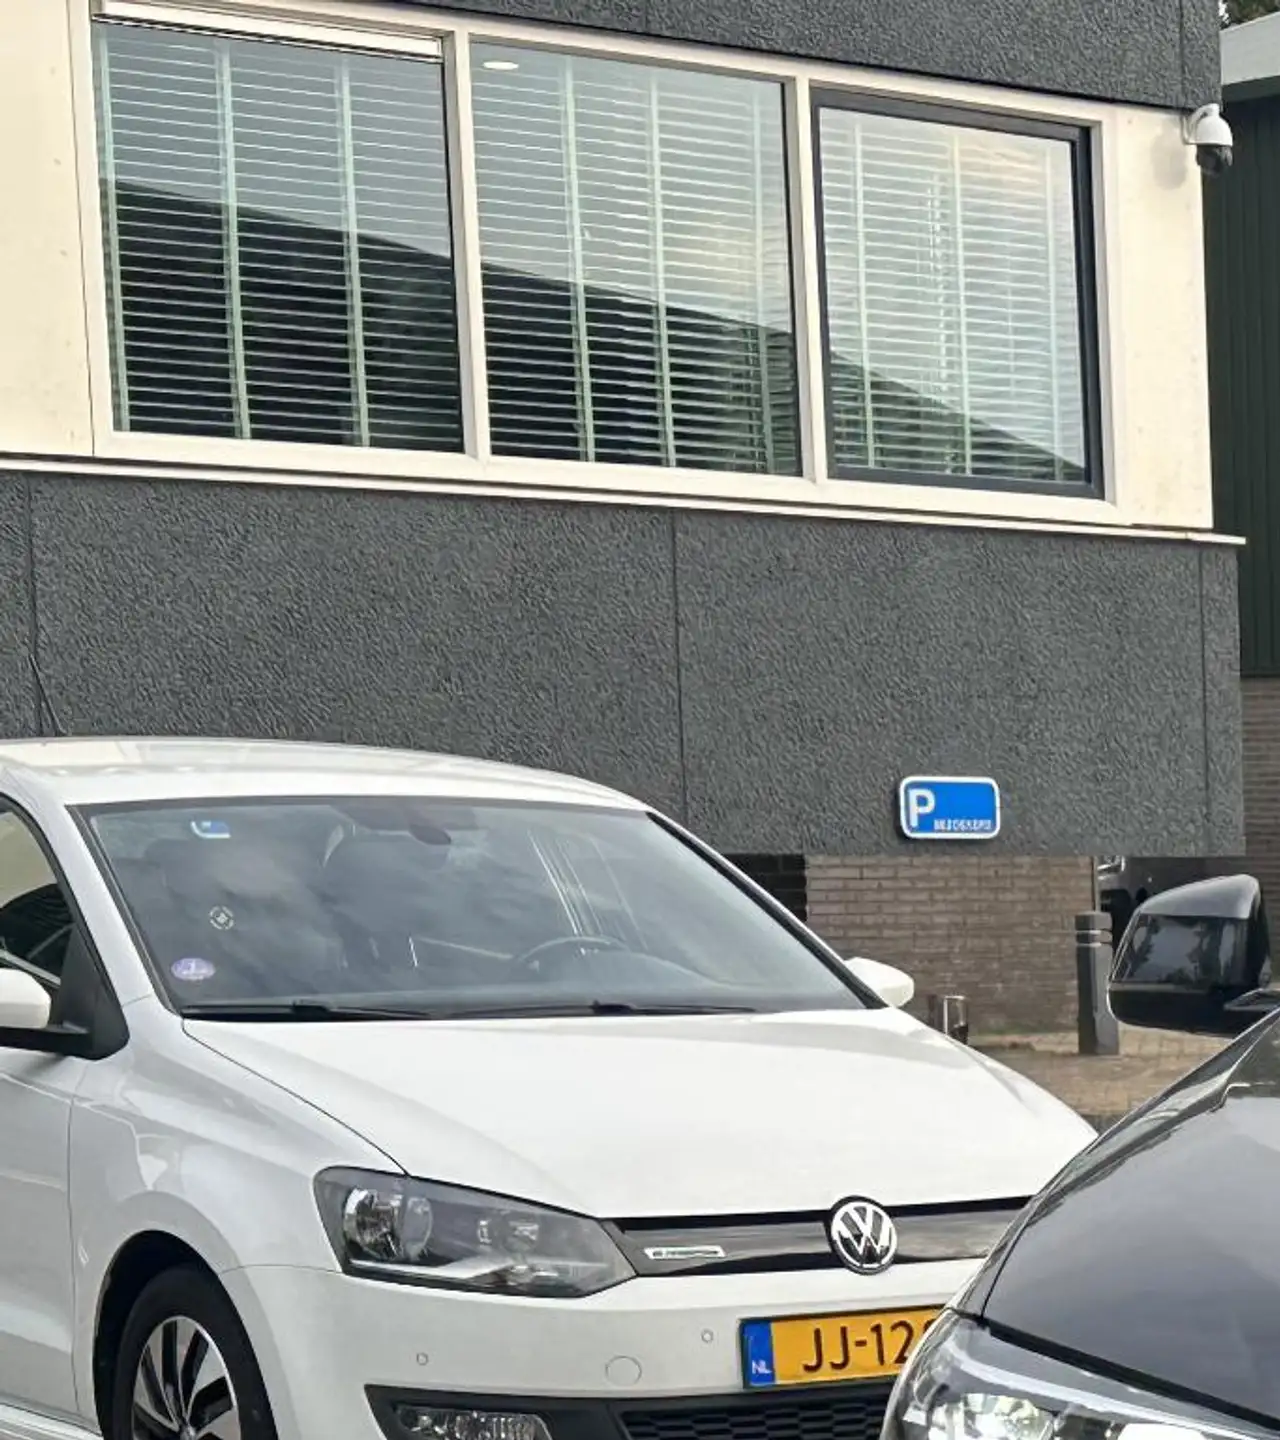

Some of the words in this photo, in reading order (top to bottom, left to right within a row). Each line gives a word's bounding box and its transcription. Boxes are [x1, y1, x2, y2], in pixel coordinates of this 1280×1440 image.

[908, 788, 935, 828] P
[802, 1318, 937, 1373] JJ-12
[751, 1359, 773, 1375] NL
